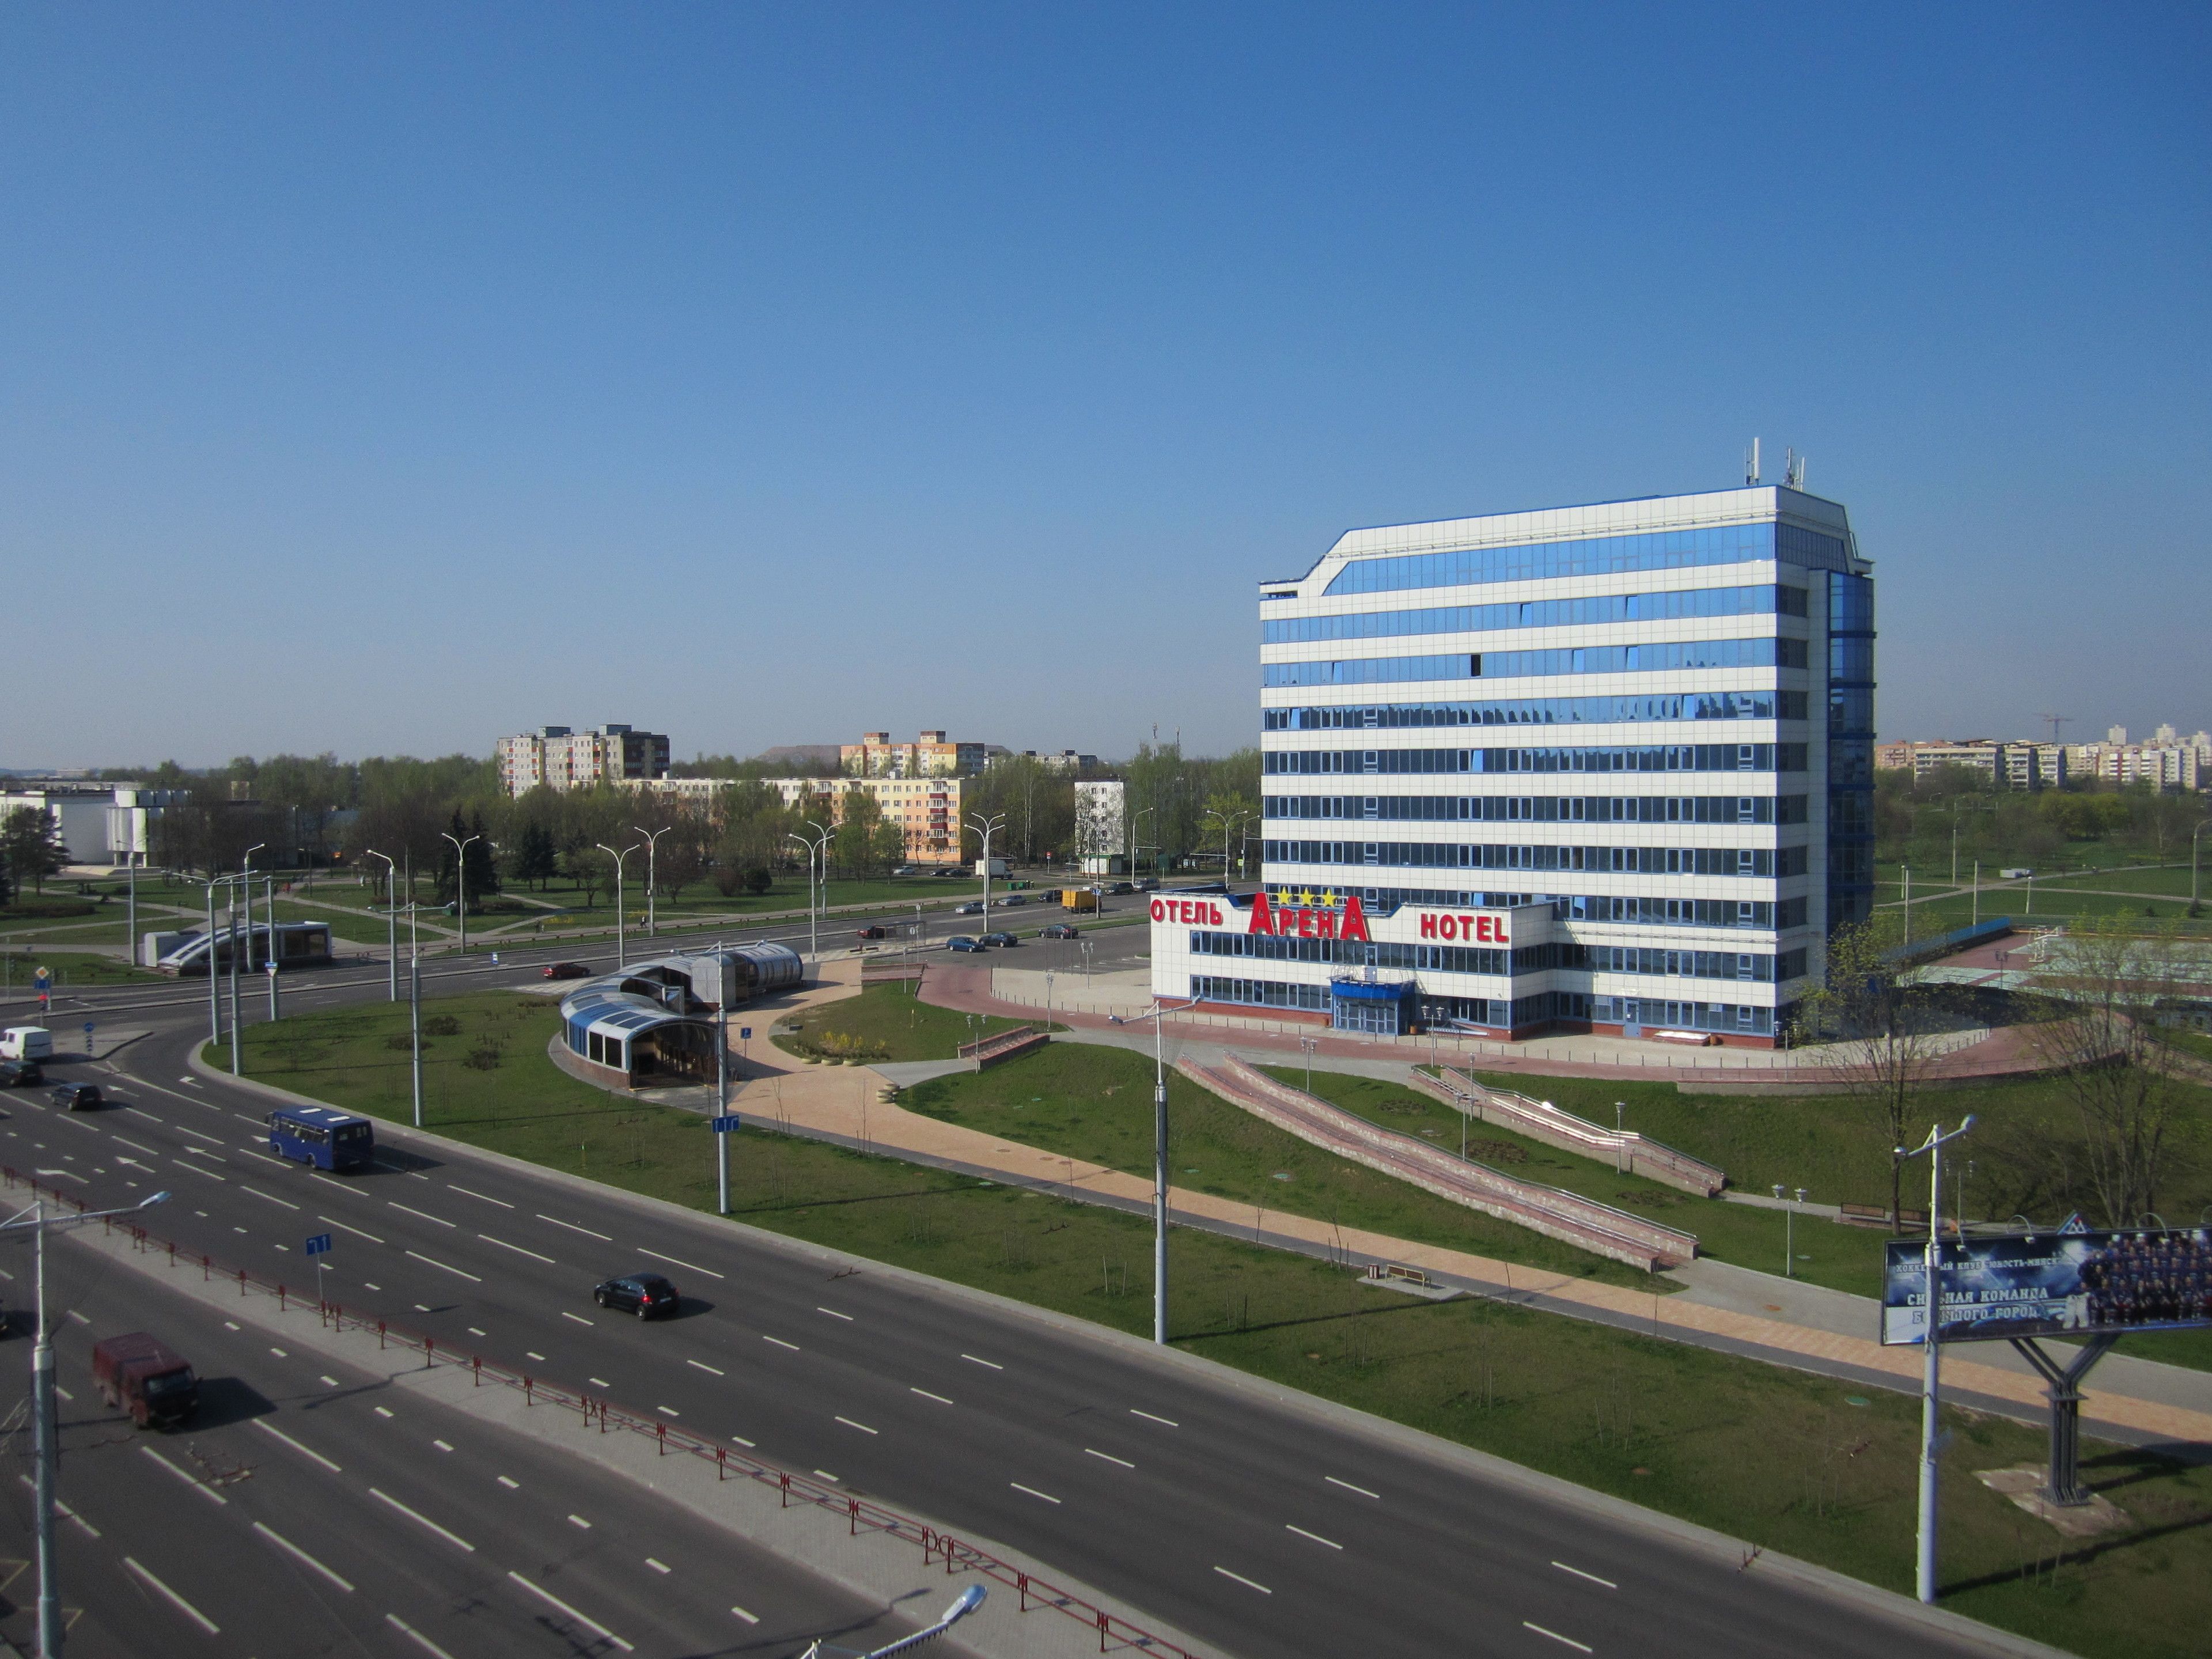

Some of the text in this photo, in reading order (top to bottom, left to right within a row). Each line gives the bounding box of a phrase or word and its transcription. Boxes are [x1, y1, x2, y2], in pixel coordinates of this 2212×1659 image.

[1150, 892, 1369, 941] ОТЕЛЬ АРЕНА
[1421, 913, 1509, 943] HOTEL
[1896, 1260, 1953, 1273] ХОККЕЫЙ
[1980, 1287, 2048, 1302] КОМАНДА
